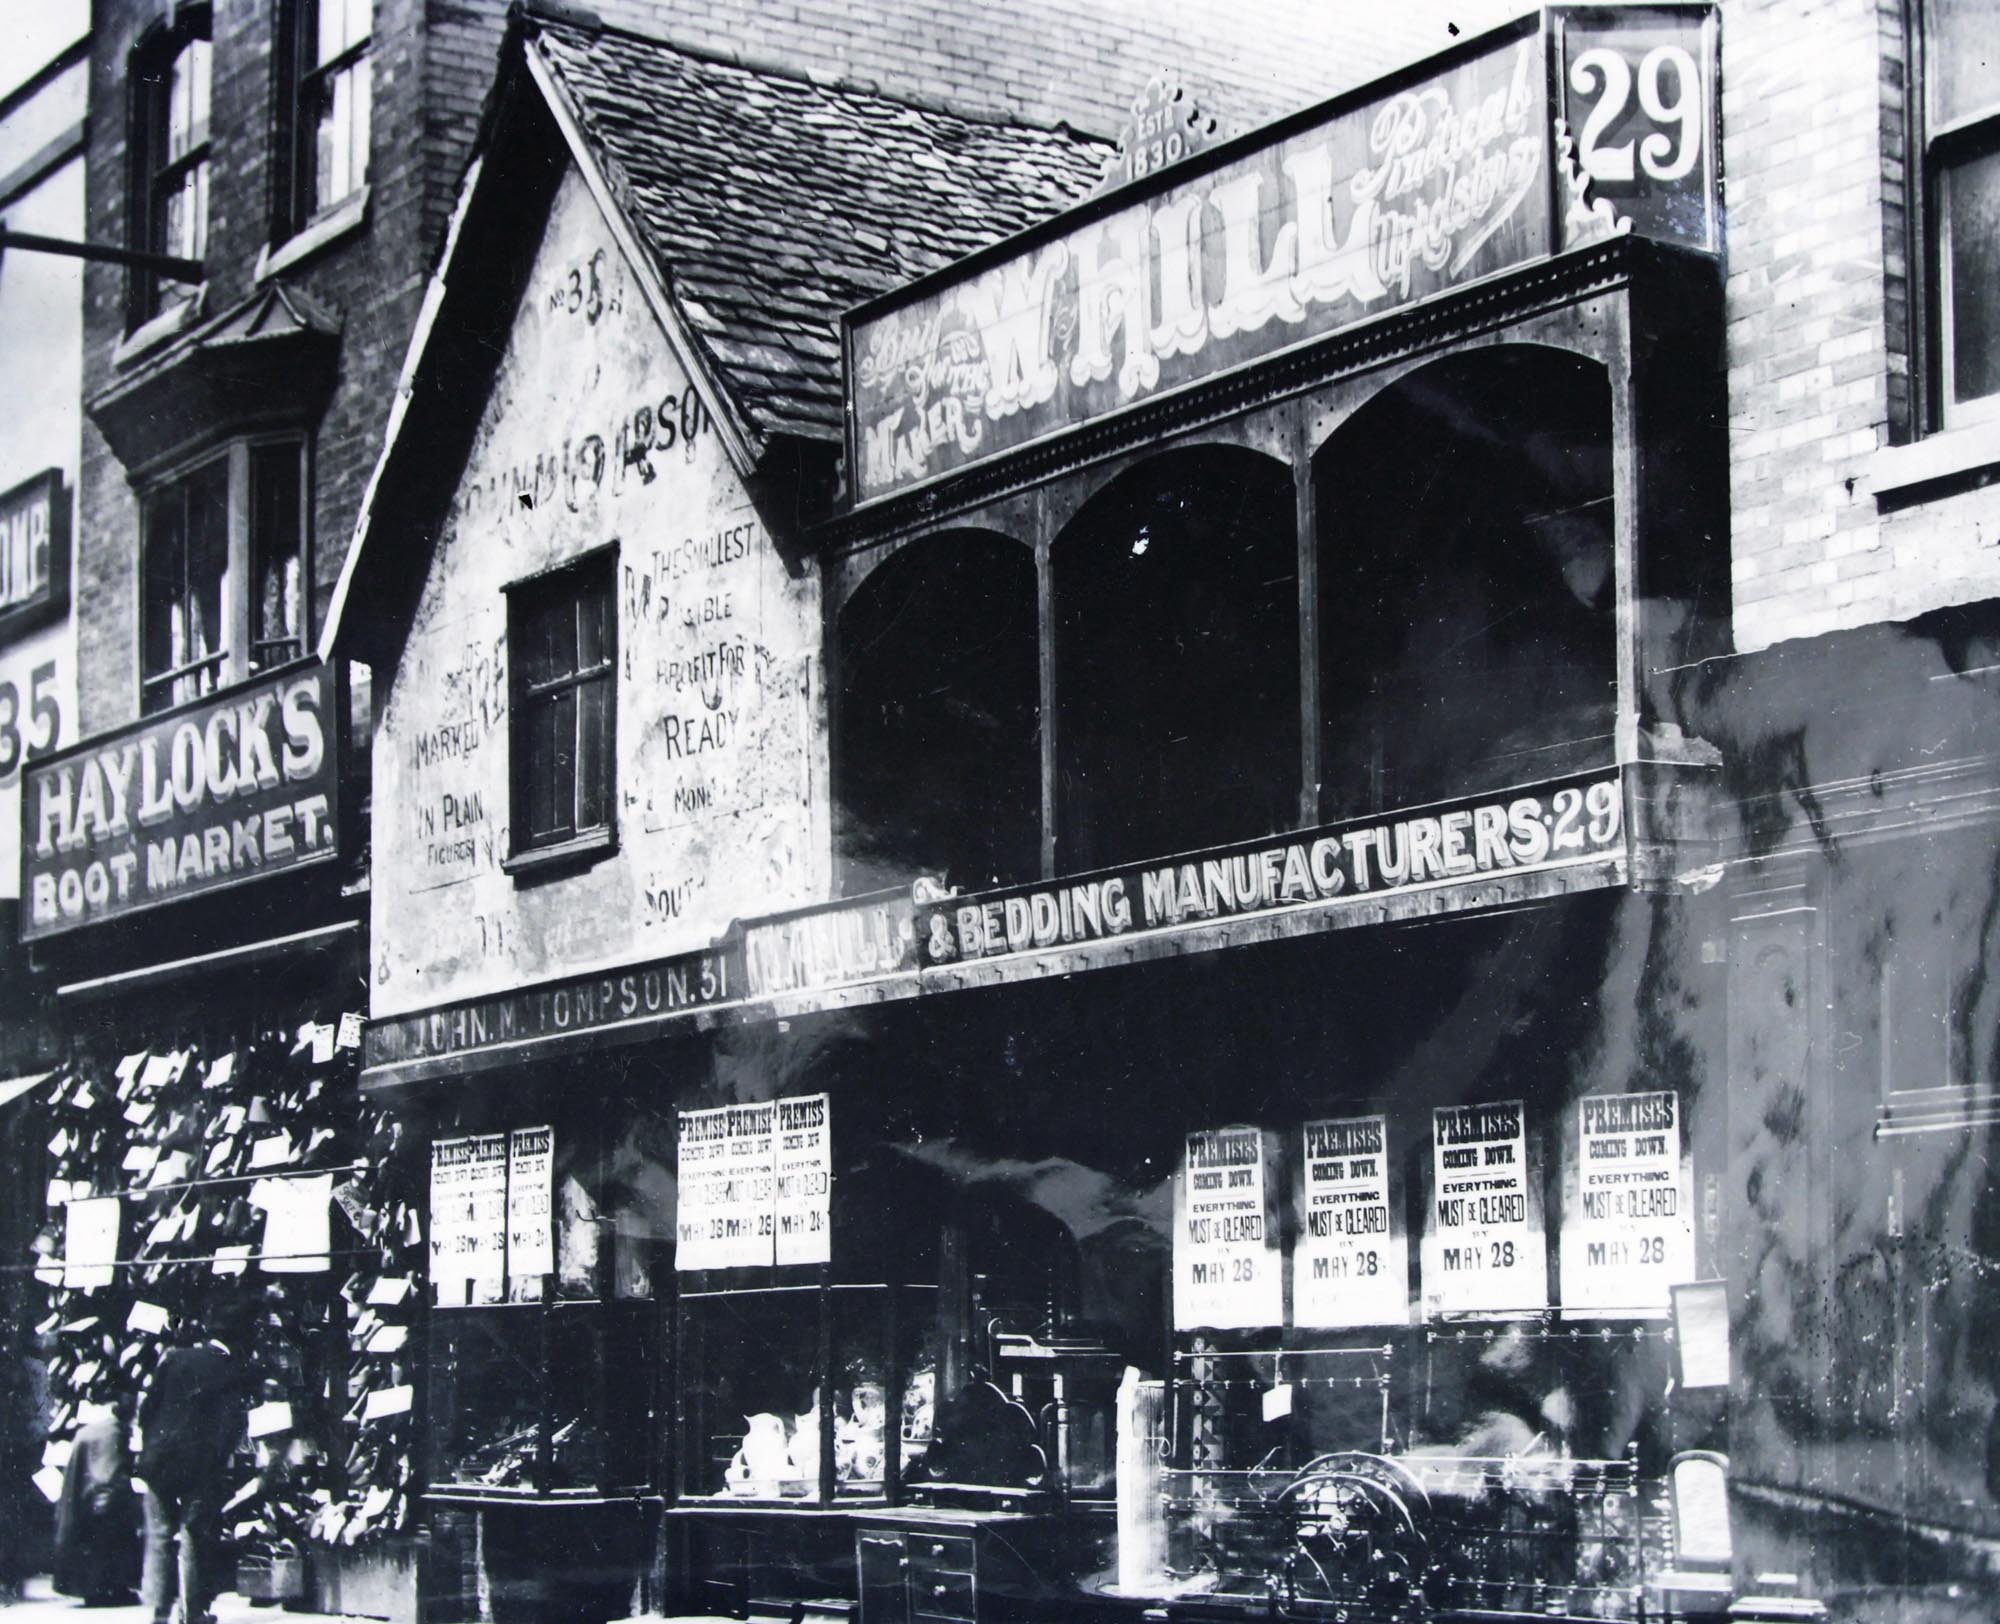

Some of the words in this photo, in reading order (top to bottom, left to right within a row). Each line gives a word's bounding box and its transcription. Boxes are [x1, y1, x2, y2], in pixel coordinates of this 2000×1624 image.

[1570, 46, 1701, 182] 29
[664, 707, 739, 760] READY
[36, 676, 324, 860] HAYLOCK'S
[443, 789, 484, 833] PLAIN
[33, 852, 138, 927] BOOT
[147, 794, 334, 893] MARKET.
[955, 877, 1132, 961] BEDDING
[1436, 1104, 1521, 1146] PREMISES
[1583, 1094, 1674, 1135] PREMISES
[1188, 1133, 1259, 1168] PREMISES
[1306, 1121, 1382, 1159] PREMISES
[1589, 1138, 1626, 1159] COMING
[1312, 1161, 1344, 1182] COMING
[1443, 1149, 1478, 1169] COMING
[1193, 1172, 1223, 1190] COMING
[1443, 1178, 1517, 1194] EVERYTHING
[1588, 1171, 1670, 1185] EVERYTHING
[1193, 1201, 1256, 1213] EVERYTHING
[1312, 1191, 1380, 1205] EVERYTHING
[1438, 1198, 1465, 1227] MUST
[1479, 1194, 1524, 1225] CLEARED
[1583, 1190, 1611, 1220] MUST
[1628, 1188, 1677, 1219] CLEARED
[1189, 1217, 1211, 1244] MUST
[1223, 1215, 1262, 1243] CLEARED
[1308, 1210, 1333, 1237] MUST
[1345, 1206, 1387, 1235] CLEARED
[1313, 1256, 1348, 1280] MAY
[1356, 1250, 1379, 1277] 28
[1444, 1247, 1482, 1271] MAY
[1491, 1241, 1515, 1268] 28
[1588, 1241, 1630, 1266] MAY
[1640, 1236, 1665, 1264] 28
[1192, 1262, 1225, 1285] MAY
[1232, 1258, 1253, 1282] 28
